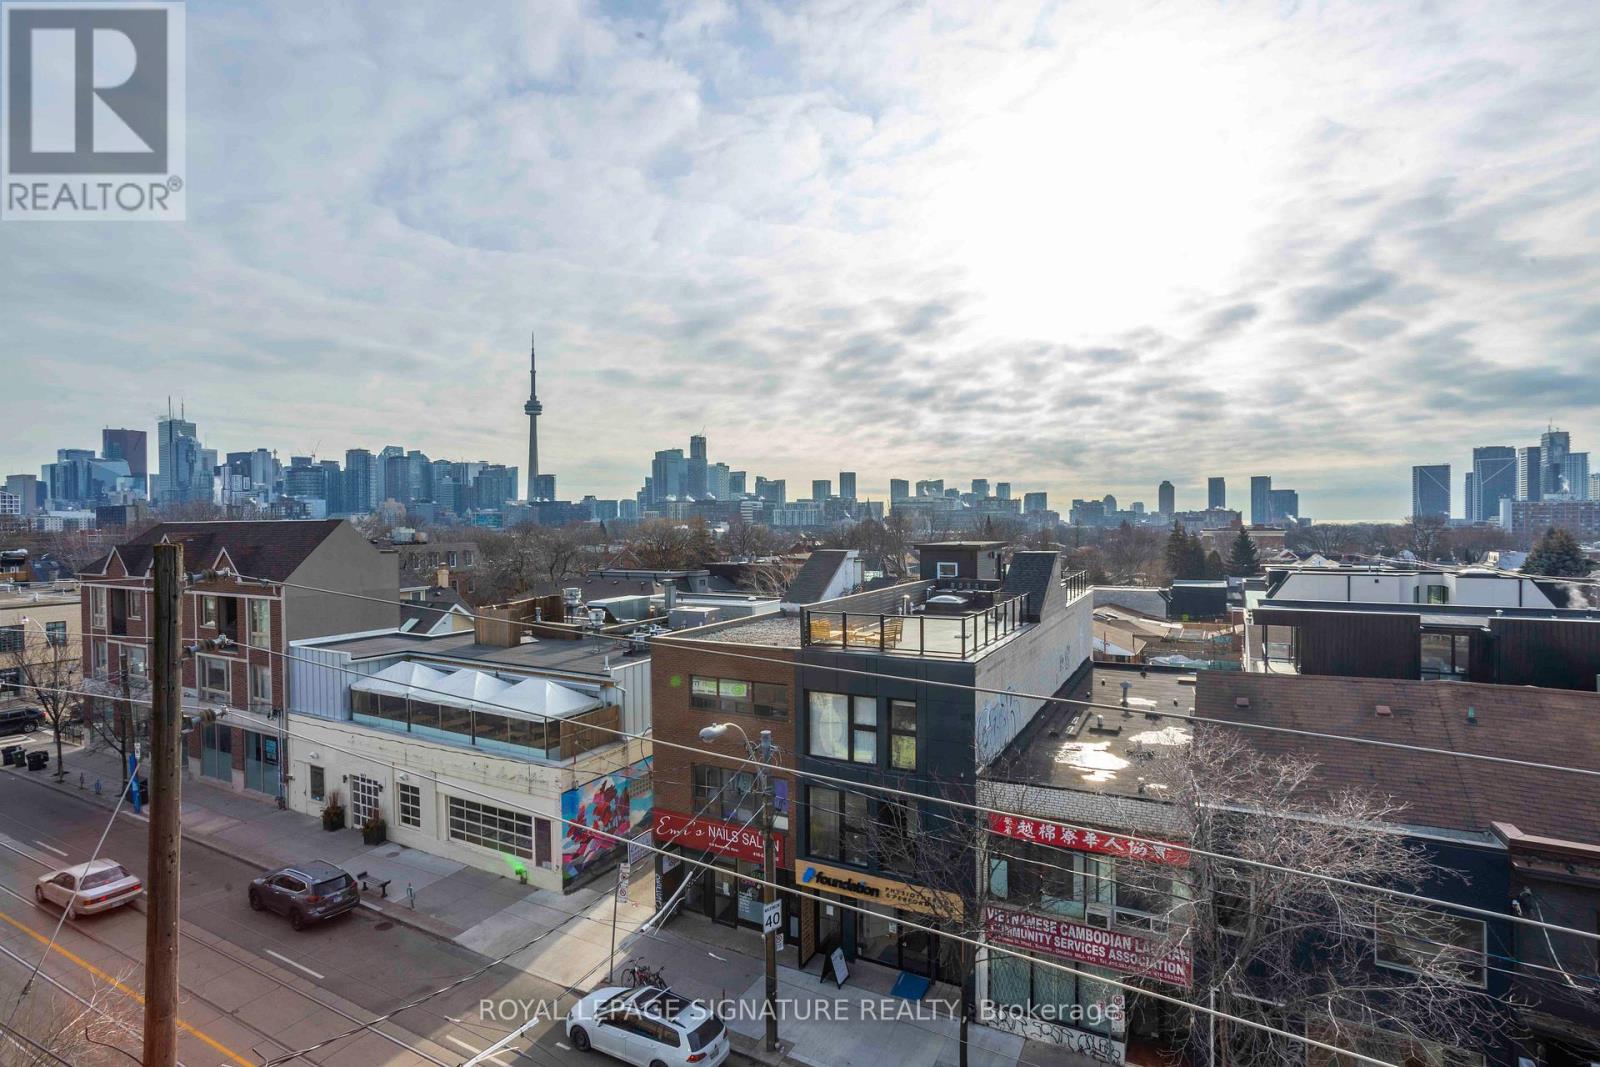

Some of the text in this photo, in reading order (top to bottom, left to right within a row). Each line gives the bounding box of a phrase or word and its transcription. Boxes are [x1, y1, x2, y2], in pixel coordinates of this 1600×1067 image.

[708, 825, 739, 843] NAILS
[742, 832, 780, 852] SALN
[815, 871, 880, 897] foundation
[765, 912, 780, 928] 40
[1060, 924, 1131, 951] CAMBODIAN
